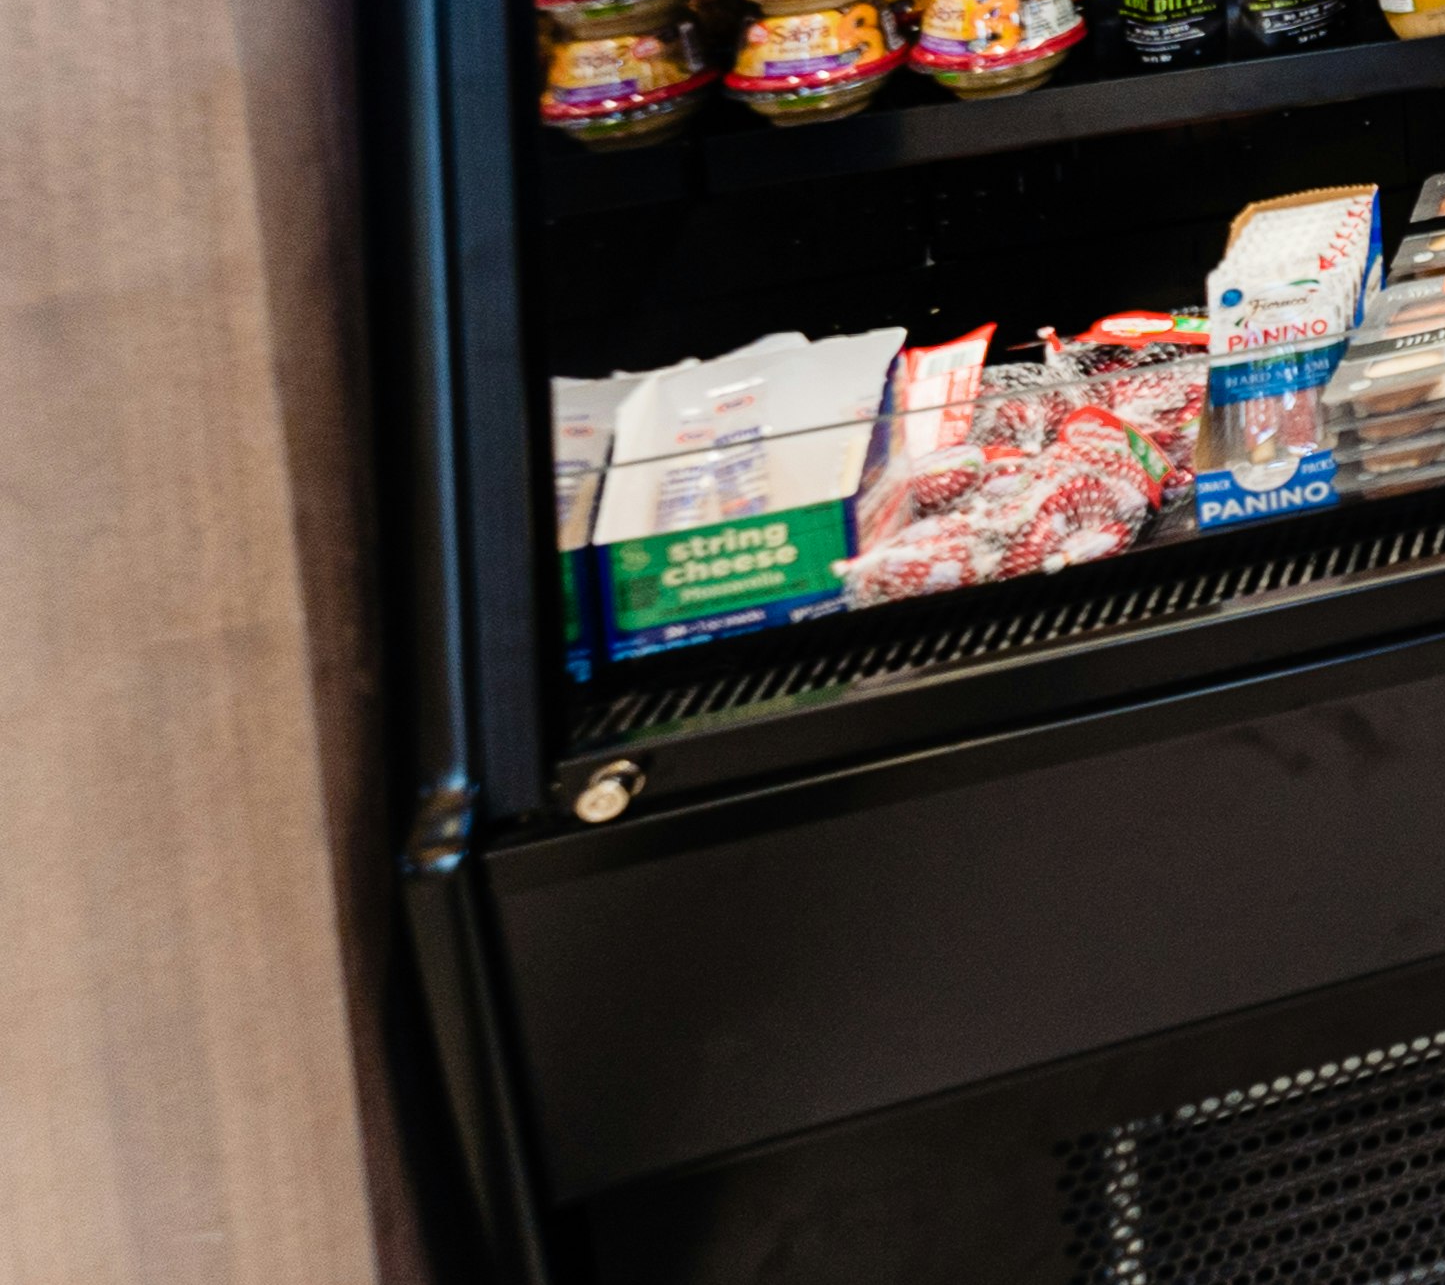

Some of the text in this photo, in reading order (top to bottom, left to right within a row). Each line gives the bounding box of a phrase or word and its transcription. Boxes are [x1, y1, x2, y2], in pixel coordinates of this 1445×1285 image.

[1228, 318, 1329, 353] PANINO
[1200, 480, 1331, 524] PANINO
[667, 521, 789, 562] string
[661, 544, 799, 587] cheese
